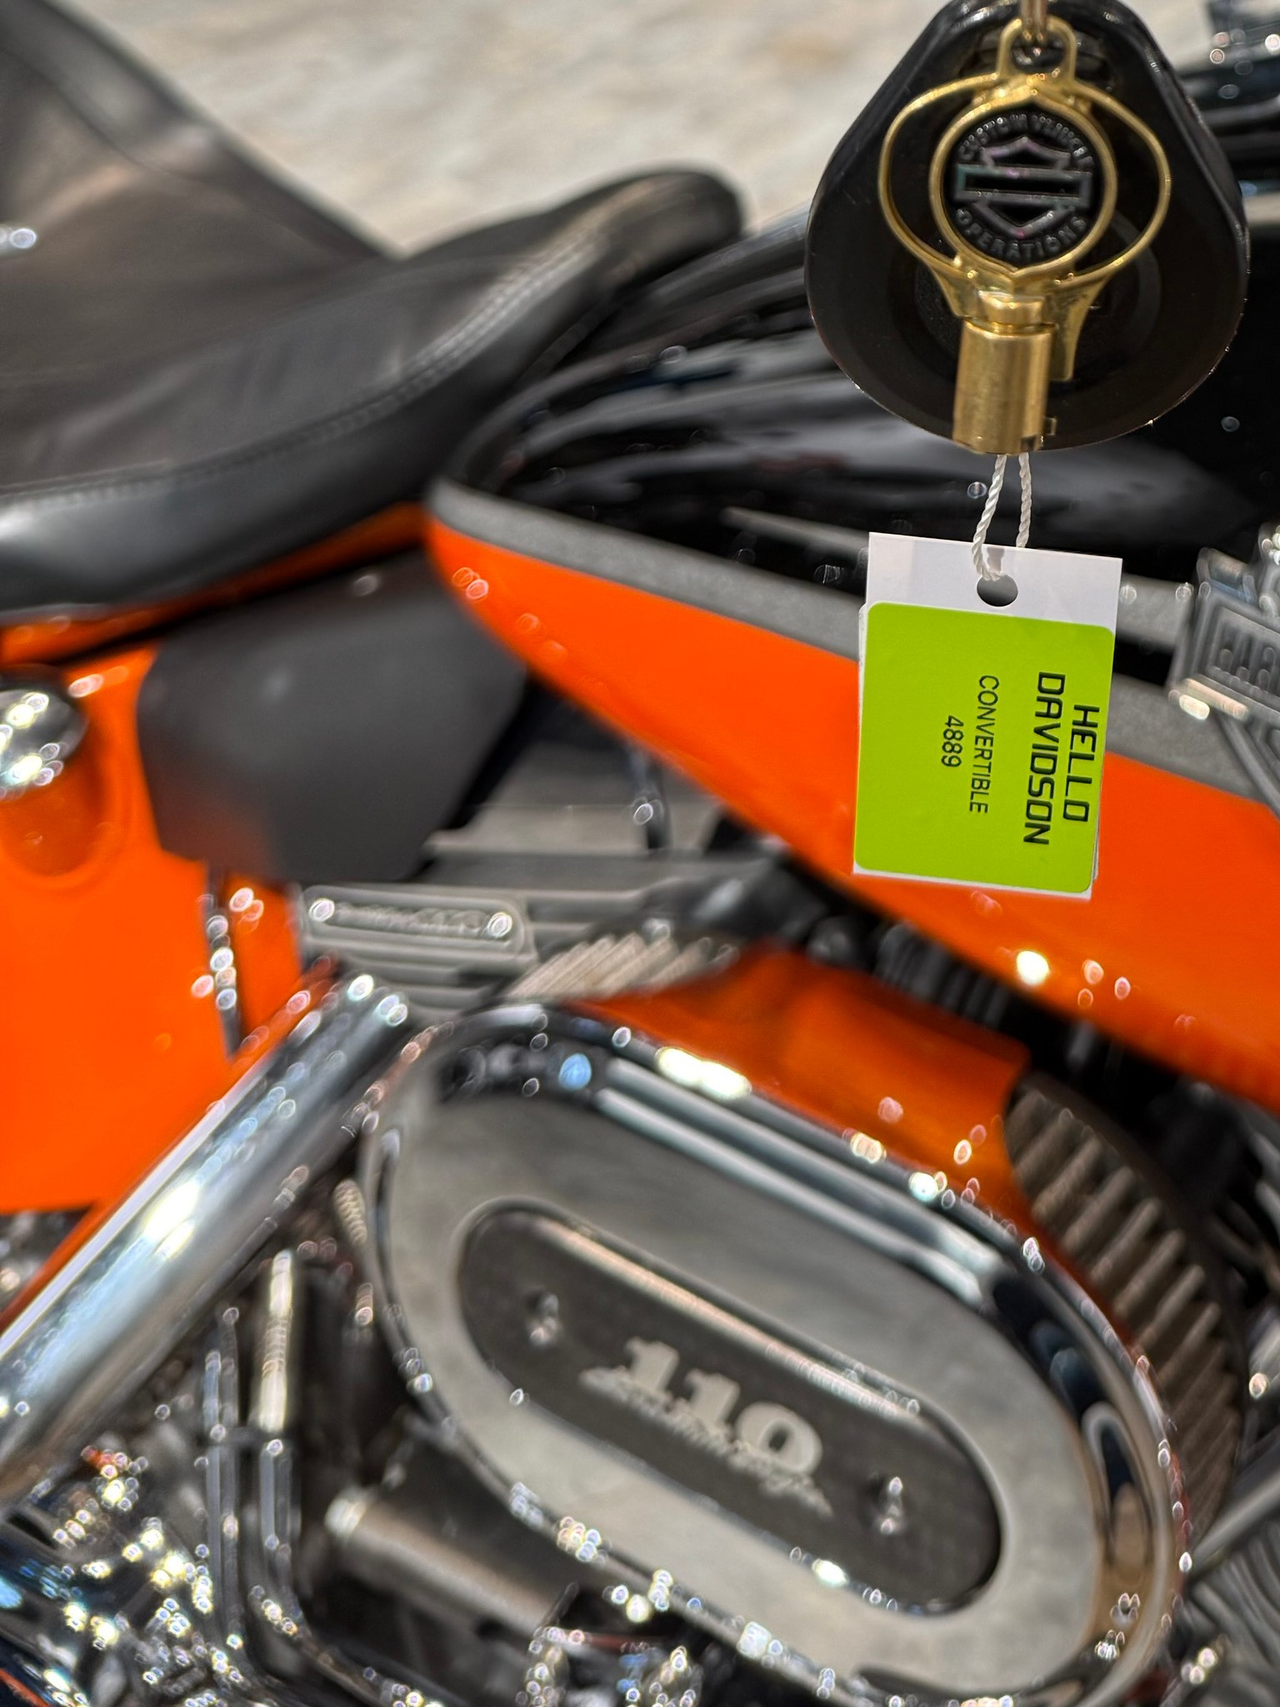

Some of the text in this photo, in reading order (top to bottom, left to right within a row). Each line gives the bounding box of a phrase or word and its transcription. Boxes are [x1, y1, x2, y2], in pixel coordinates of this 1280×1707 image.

[941, 715, 965, 769] 4889
[969, 675, 1000, 814] CONVERTIBLE
[1023, 671, 1066, 845] DAVIDSON
[1062, 704, 1100, 823] HELLO
[618, 1337, 824, 1477] 110
